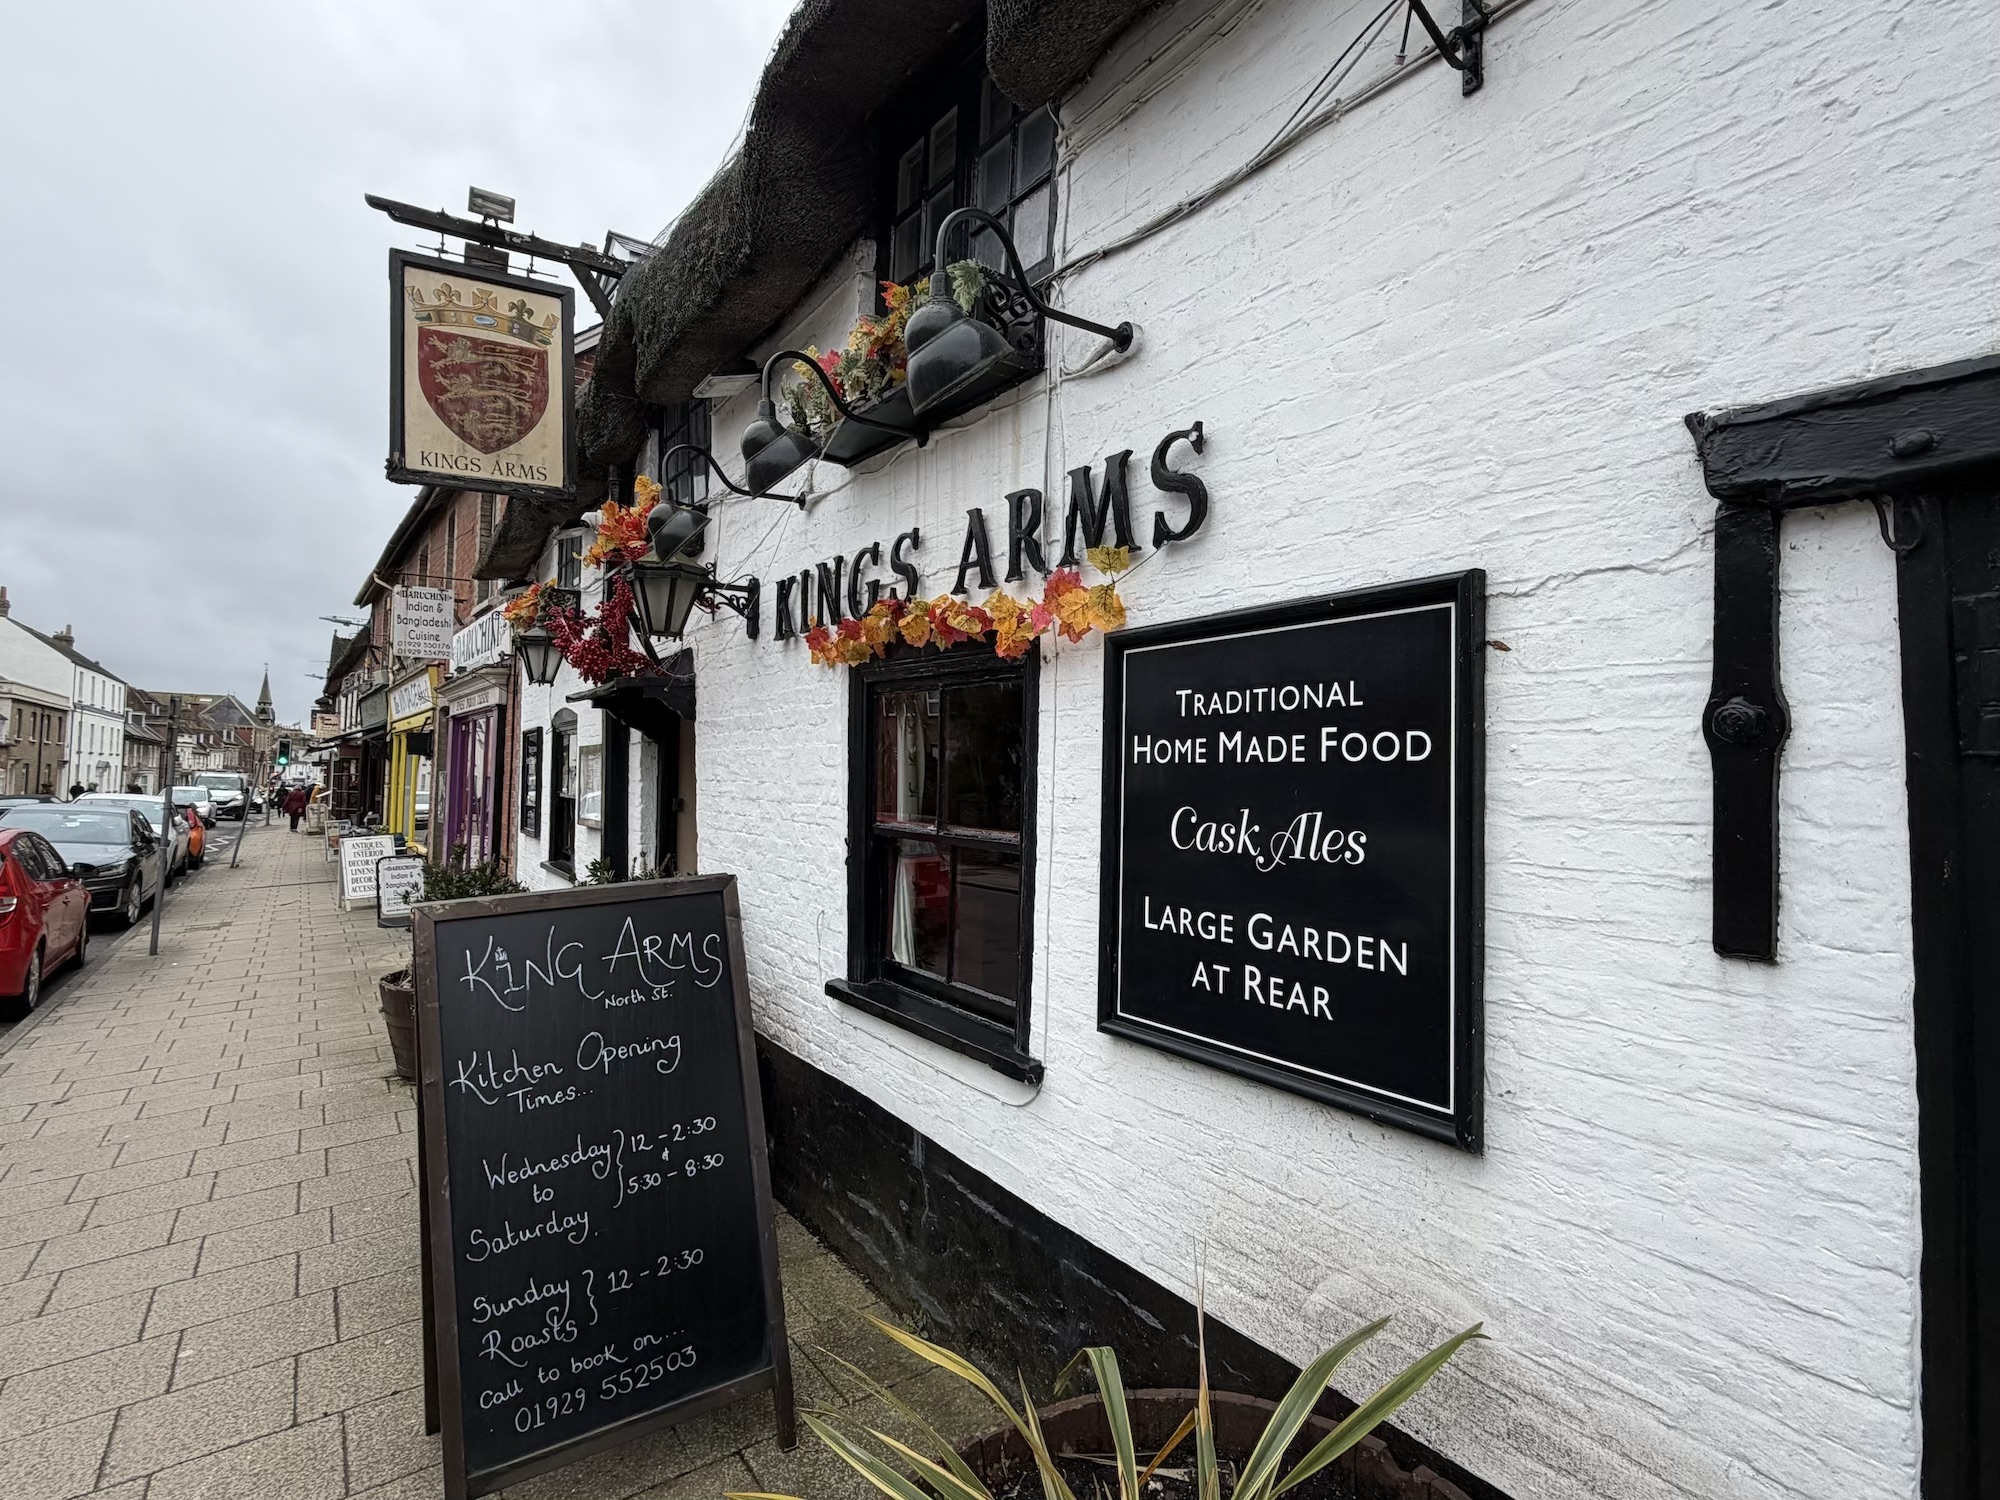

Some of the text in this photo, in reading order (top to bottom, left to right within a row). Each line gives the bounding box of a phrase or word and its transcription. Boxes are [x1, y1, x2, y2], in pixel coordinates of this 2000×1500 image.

[420, 450, 548, 482] KINGS ARMS
[774, 421, 1208, 641] KINGS ARMS
[400, 590, 447, 601] DARUCHINI
[407, 601, 444, 613] Indian &
[396, 614, 452, 628] Bangladeshi
[408, 629, 440, 642] Cuisine
[397, 640, 421, 648] 01929
[397, 647, 421, 655] 01929
[456, 613, 500, 667] DARUCHINI
[1176, 680, 1364, 717] TRADITIONAL
[1133, 727, 1432, 764] HOME MADE FOOD
[353, 849, 384, 858] INTERIOR
[1171, 806, 1367, 872] Cask Ales
[350, 867, 375, 876] LINENS
[350, 885, 377, 893] ACCESS
[351, 876, 373, 884] DECOR
[601, 916, 723, 988] ARMS
[1144, 896, 1408, 976] LARGE GARDEN
[605, 987, 674, 1009] North St.
[1192, 961, 1334, 1021] AT REAR
[449, 1031, 681, 1106] Kitchen Opening
[631, 1133, 654, 1153] 12
[671, 1116, 718, 1142] 2:30
[483, 1134, 612, 1190] Wednesday
[627, 1172, 662, 1194] 5:30
[685, 1153, 725, 1177] 8:30
[532, 1183, 555, 1204] to
[607, 1269, 634, 1293] 12
[657, 1248, 705, 1277] 2:30
[472, 1277, 572, 1328] Sunday
[478, 1316, 579, 1368] Roasts
[537, 1366, 561, 1384] to
[571, 1344, 628, 1375] book
[514, 1345, 698, 1433] 01929 552503
